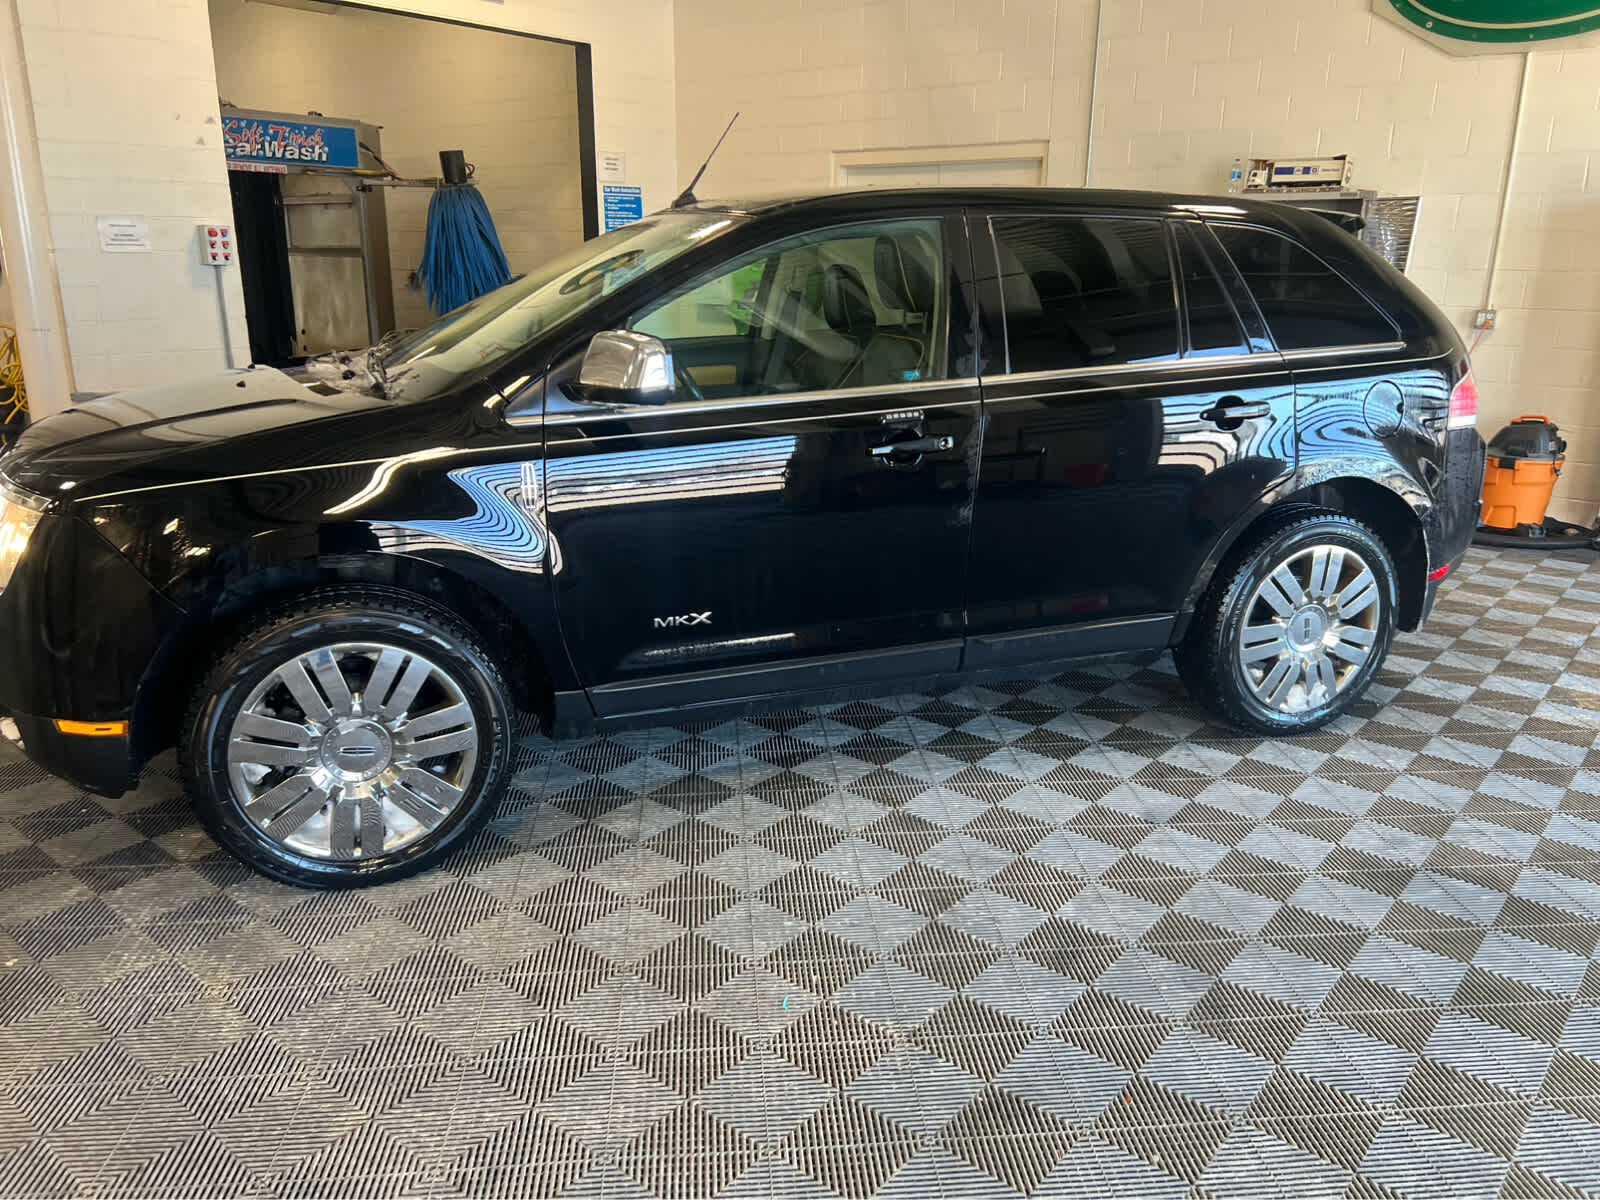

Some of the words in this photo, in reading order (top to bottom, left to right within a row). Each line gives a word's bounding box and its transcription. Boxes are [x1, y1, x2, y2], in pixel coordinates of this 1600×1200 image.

[224, 120, 263, 152] Soft
[264, 141, 329, 162] Wash
[653, 611, 712, 628] MKX
